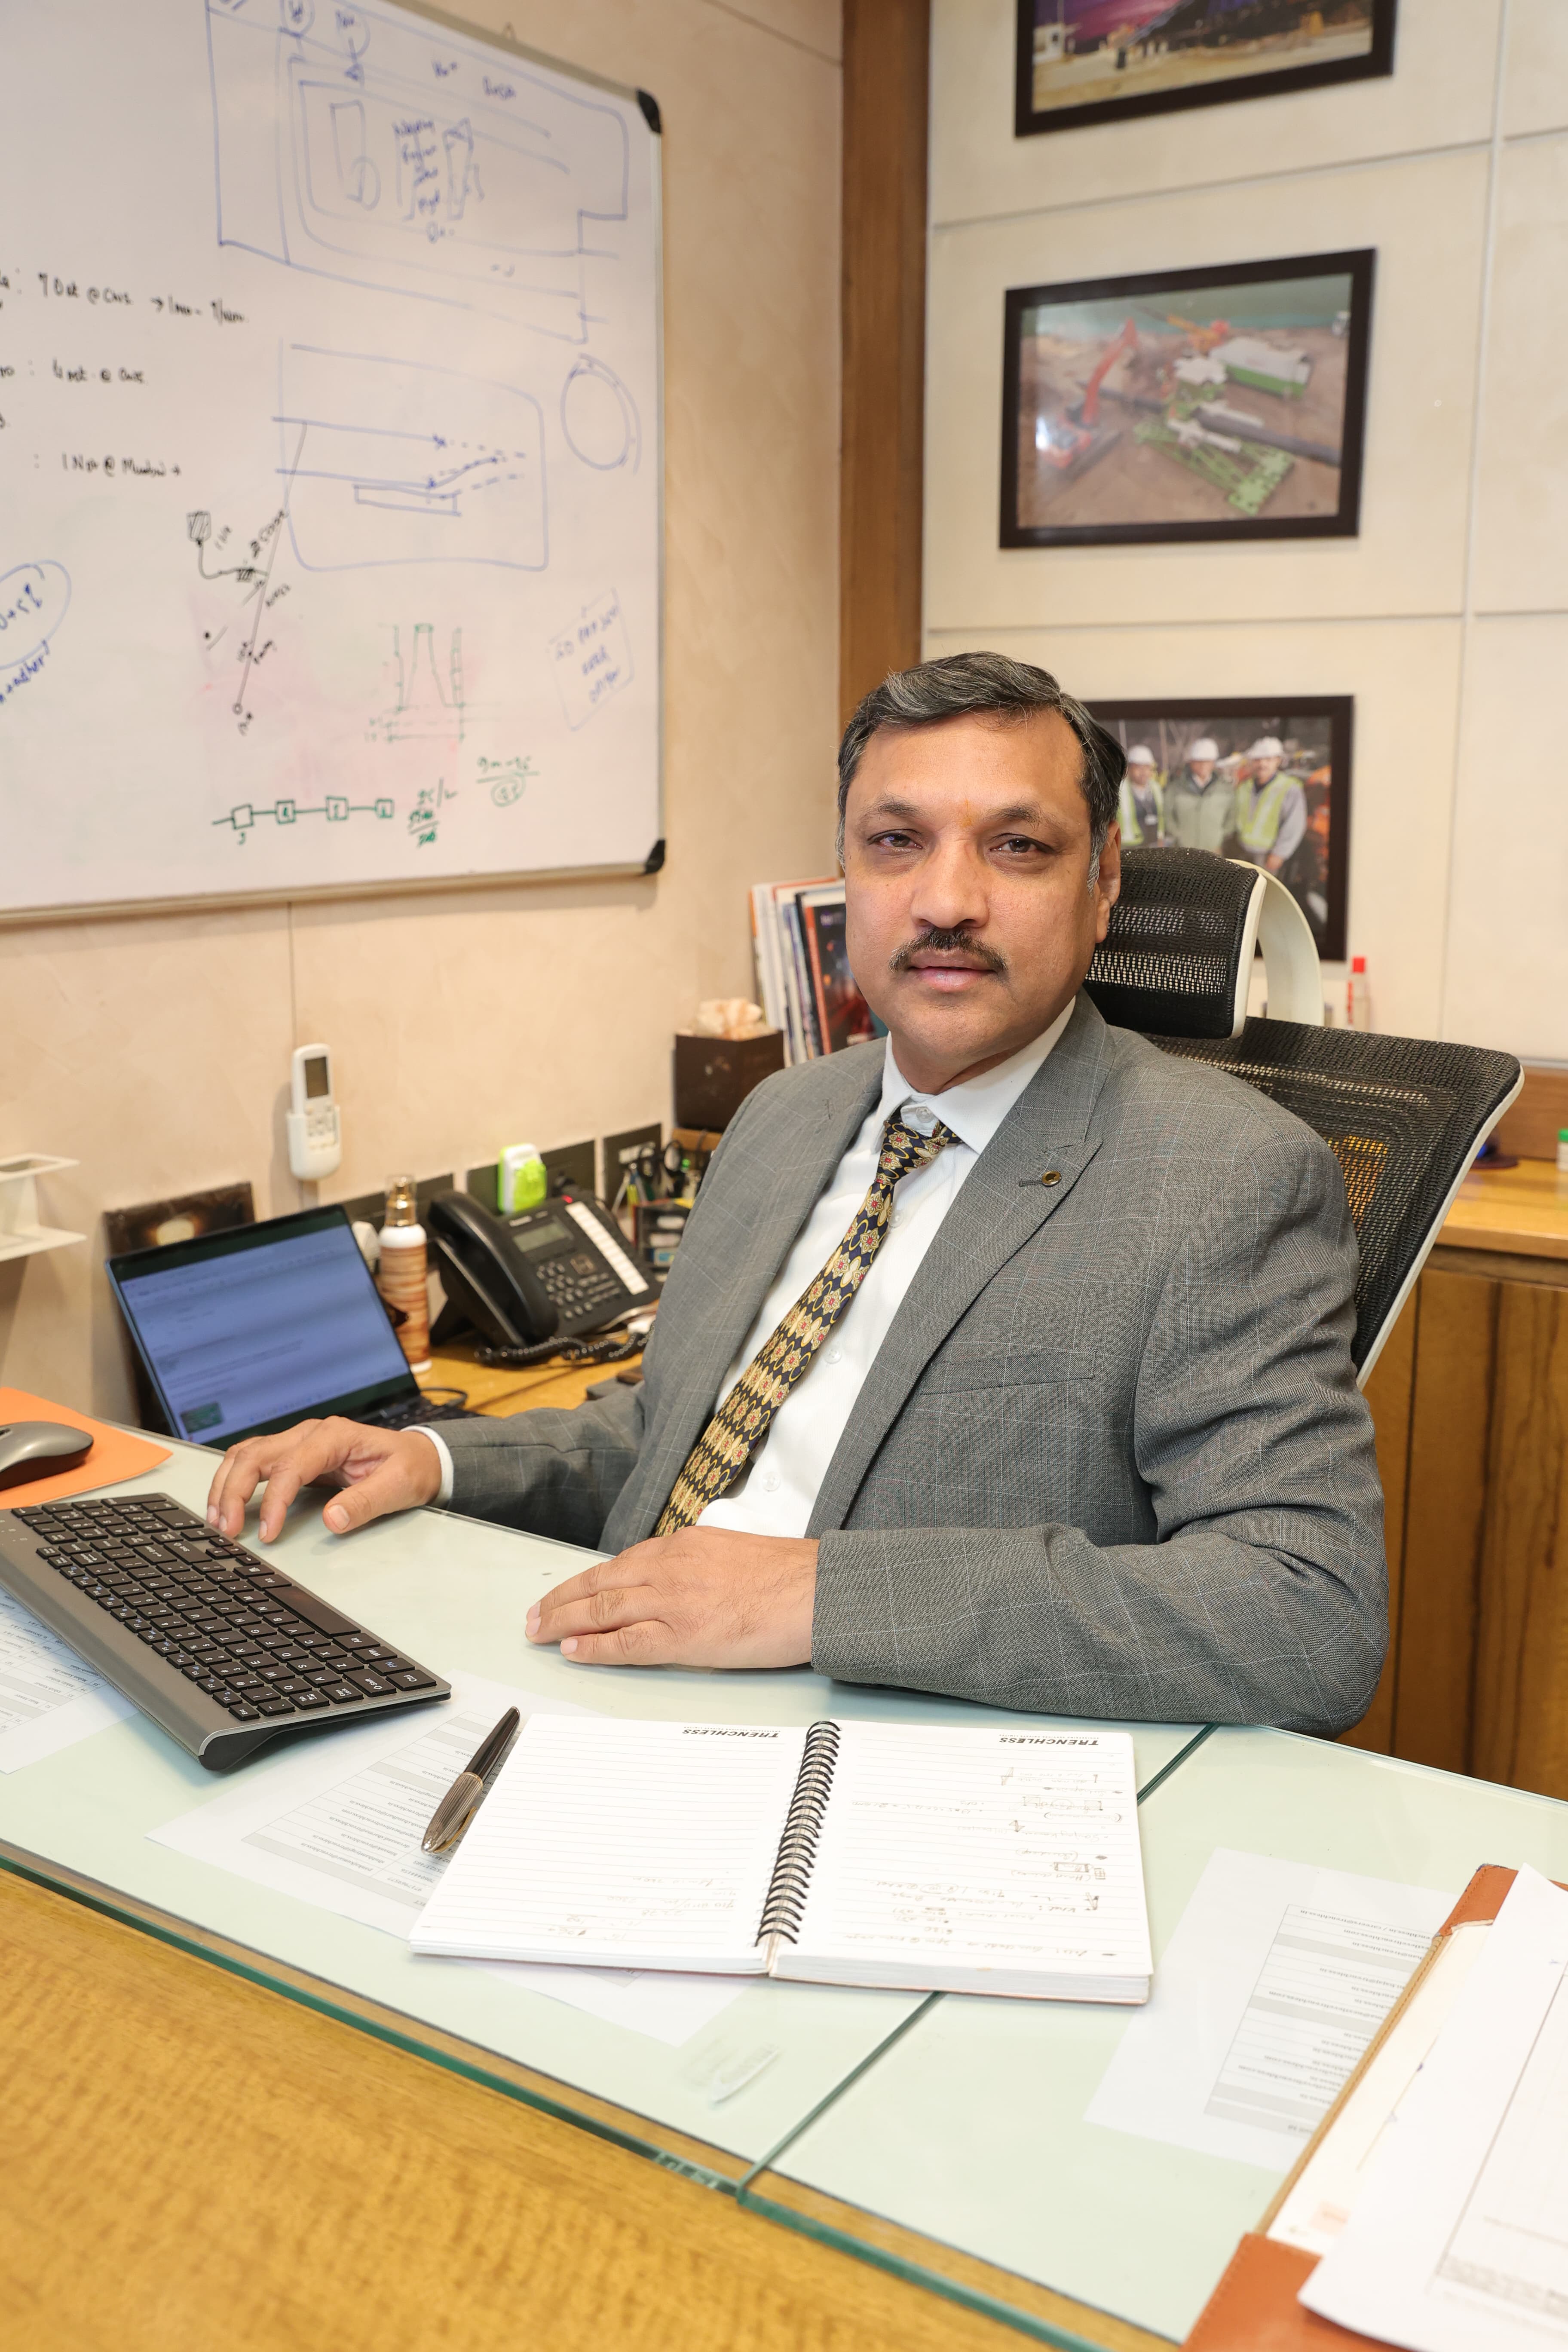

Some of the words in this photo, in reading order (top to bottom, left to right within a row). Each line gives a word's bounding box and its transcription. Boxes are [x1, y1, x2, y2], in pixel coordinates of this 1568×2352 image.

[364, 1678, 377, 1686] Shift
[682, 1729, 779, 1738] TRENCHLESS
[999, 1737, 1099, 1746] TRENCHLESS
[422, 1770, 455, 1785] trenchless.in
